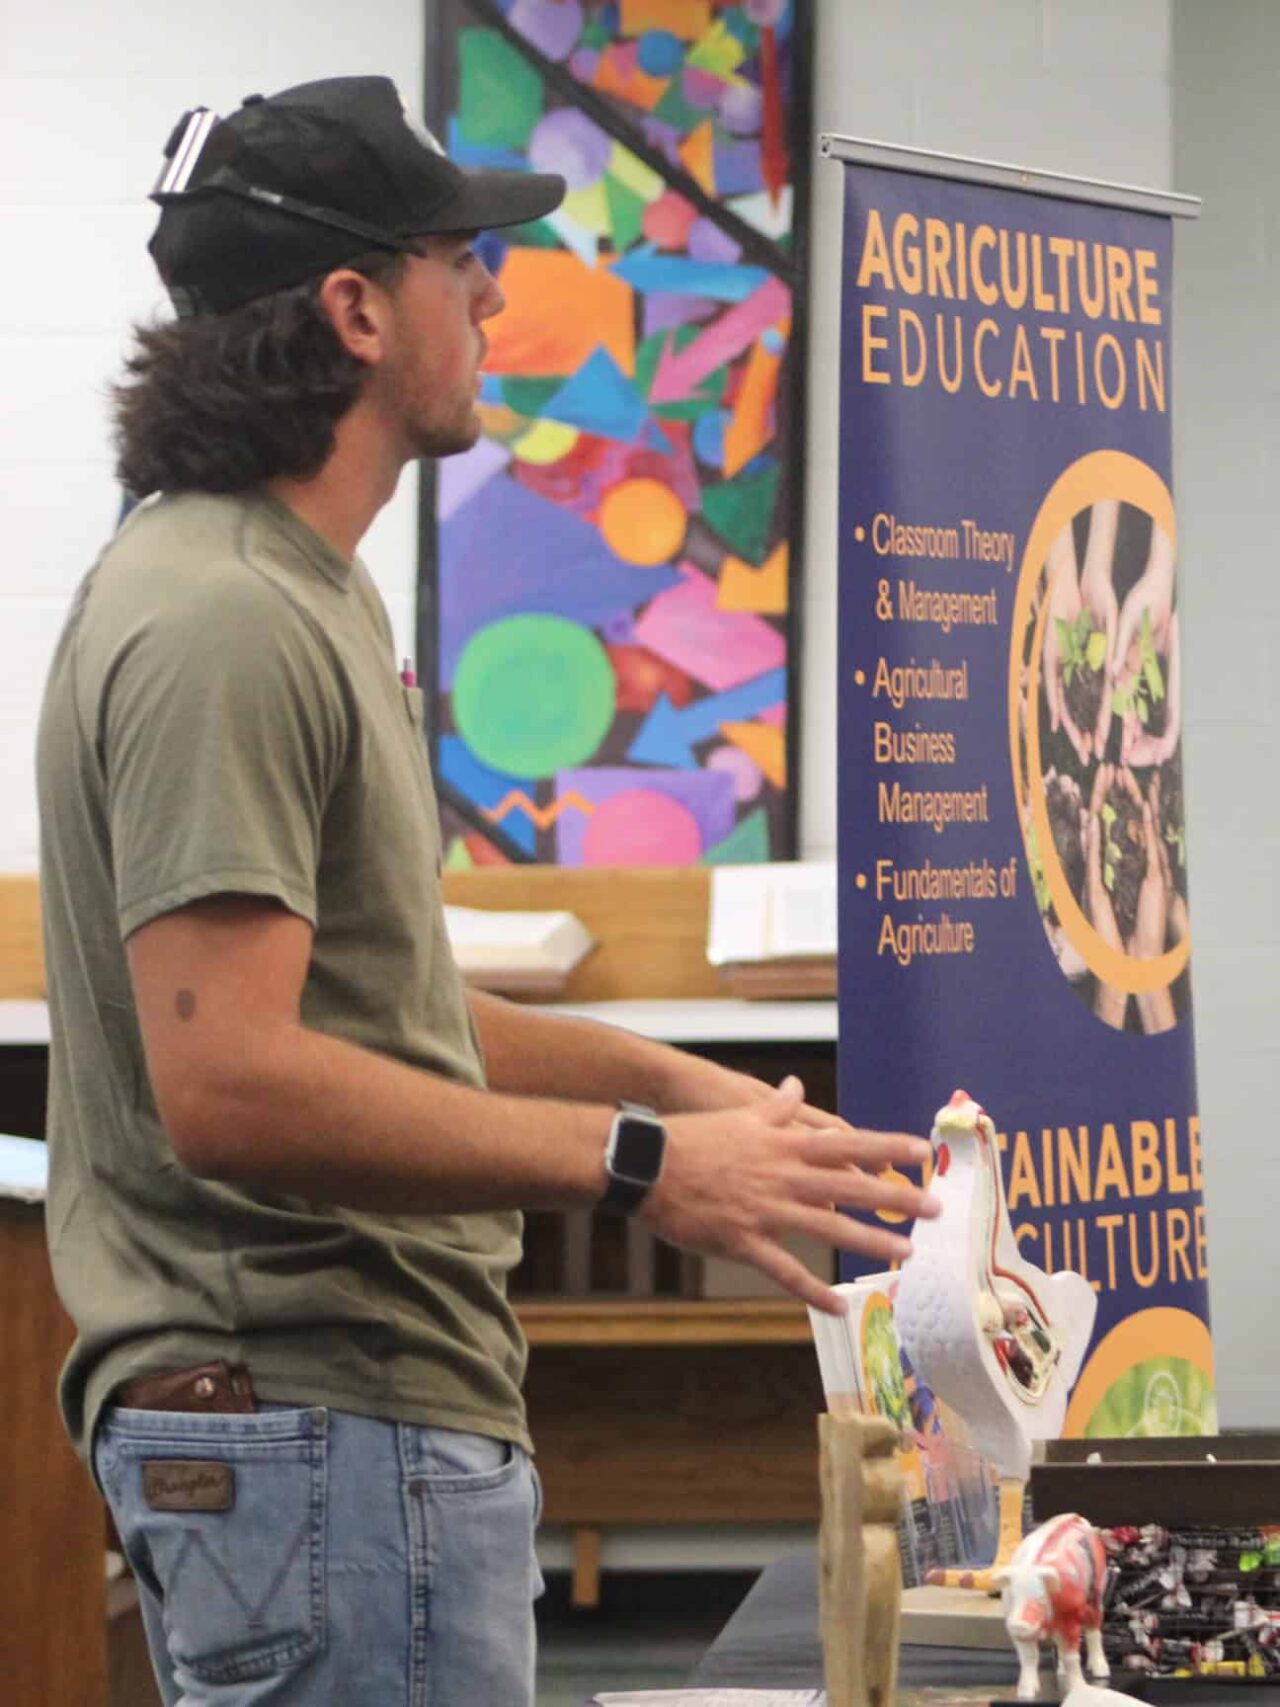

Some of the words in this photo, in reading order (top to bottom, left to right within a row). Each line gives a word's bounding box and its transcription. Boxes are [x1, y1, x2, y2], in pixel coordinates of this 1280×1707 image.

[856, 208, 1163, 325] AGRICULTURE
[861, 303, 1166, 412] EDUCATION
[872, 513, 959, 559] Classroom
[961, 519, 1015, 572] Theory
[876, 578, 893, 620] &
[899, 580, 998, 633] Management
[872, 656, 969, 708] Agricultural
[874, 721, 956, 764] Business
[878, 781, 989, 833] Management
[876, 858, 996, 901] Fundamentals
[1000, 857, 1018, 897] of
[877, 913, 976, 966] Agriculture
